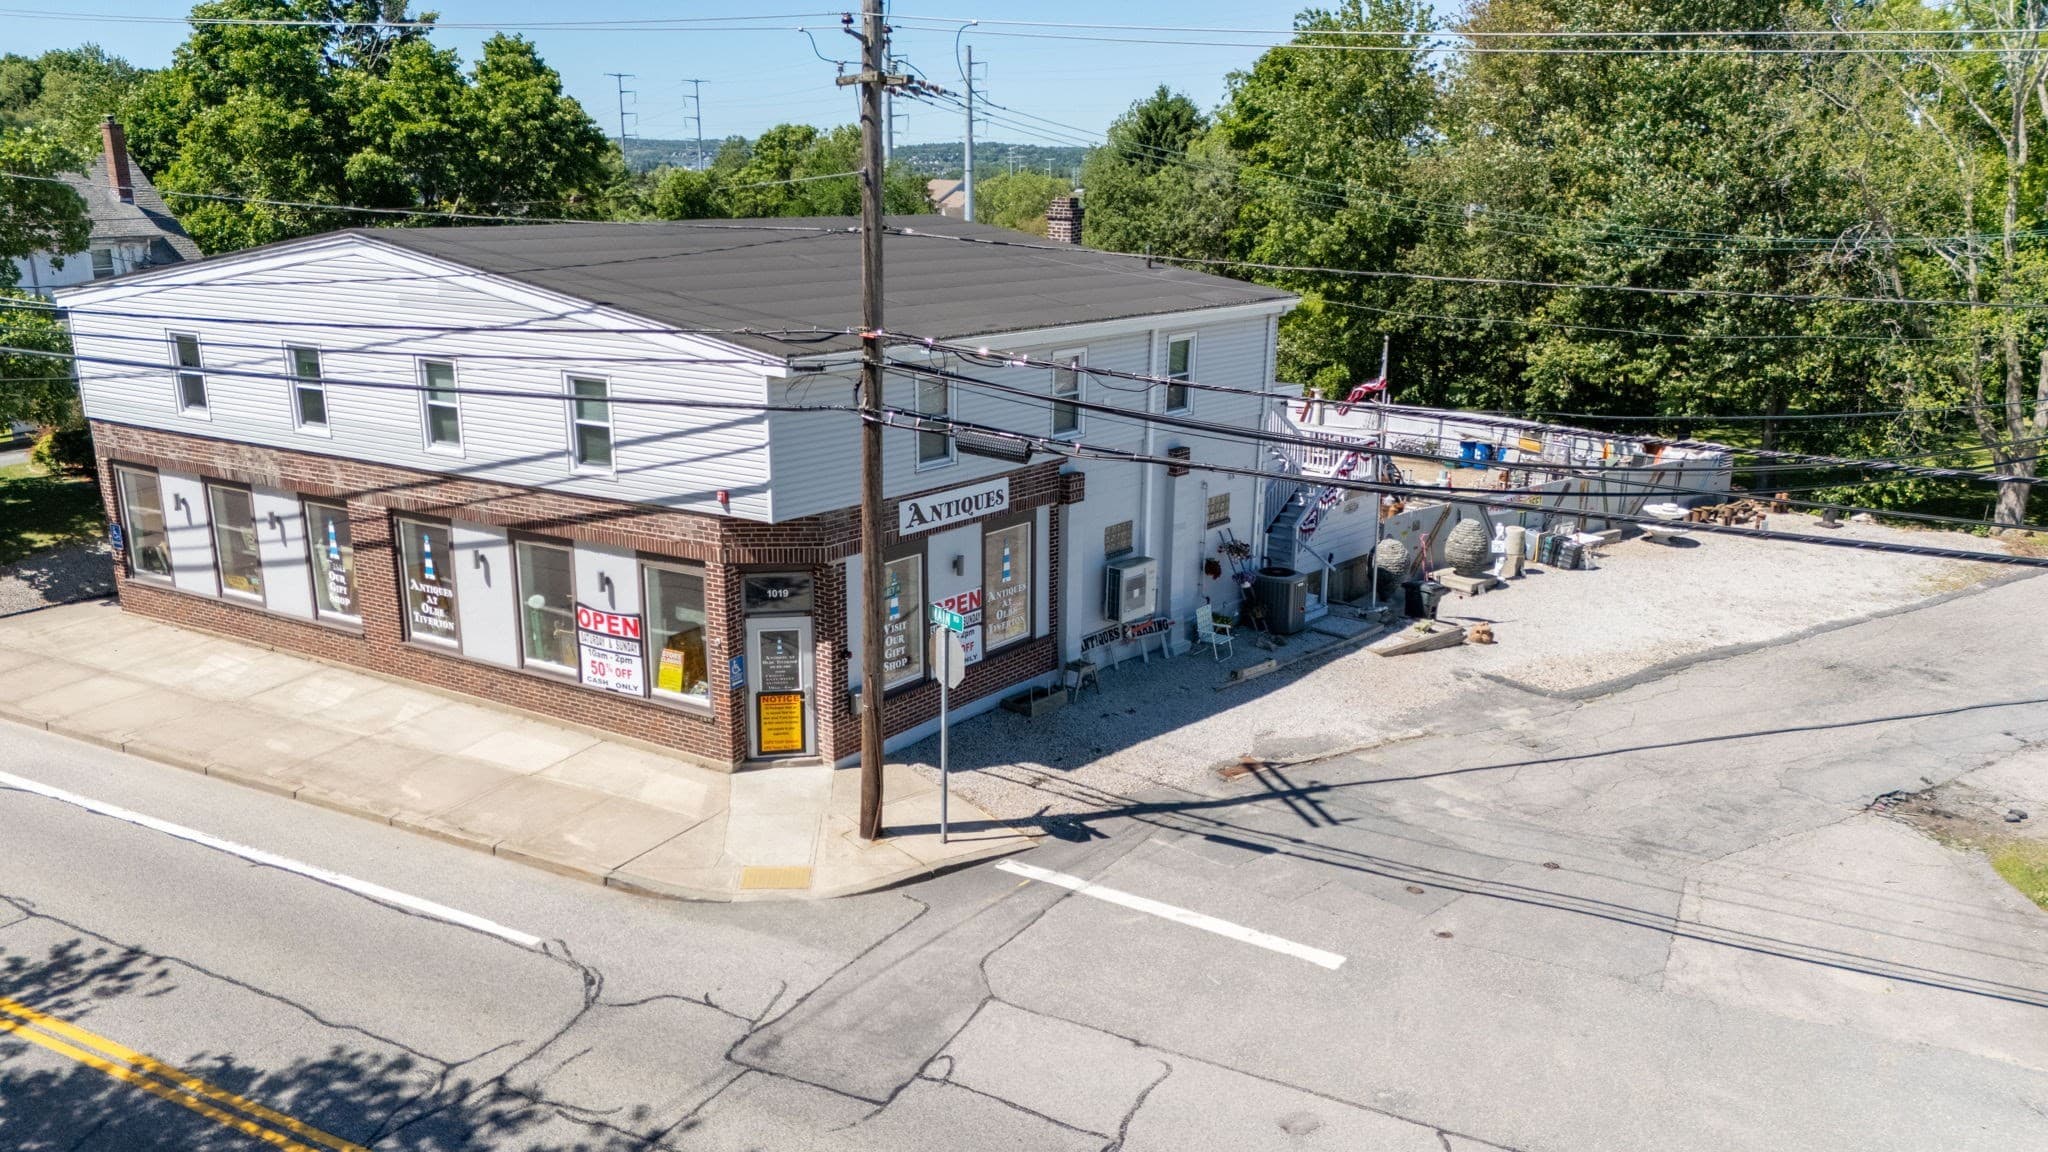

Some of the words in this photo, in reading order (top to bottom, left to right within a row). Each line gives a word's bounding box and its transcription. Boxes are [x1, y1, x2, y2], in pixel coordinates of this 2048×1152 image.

[905, 488, 1004, 529] ANTIQUES
[410, 579, 453, 598] ANTIQUES
[767, 589, 789, 598] 1019
[987, 583, 1026, 603] ANTIQUES
[935, 589, 981, 614] PEN
[413, 611, 454, 631] TIVERTON
[578, 608, 640, 637] OPEN
[883, 620, 907, 635] VISIT
[885, 634, 905, 647] OUR
[615, 654, 633, 665] 2pm
[884, 646, 906, 659] GIFT
[883, 656, 908, 673] SHOP
[615, 667, 633, 679] OFF
[587, 676, 609, 686] CASH
[615, 682, 639, 692] ONLY
[762, 695, 800, 703] NOTICE
